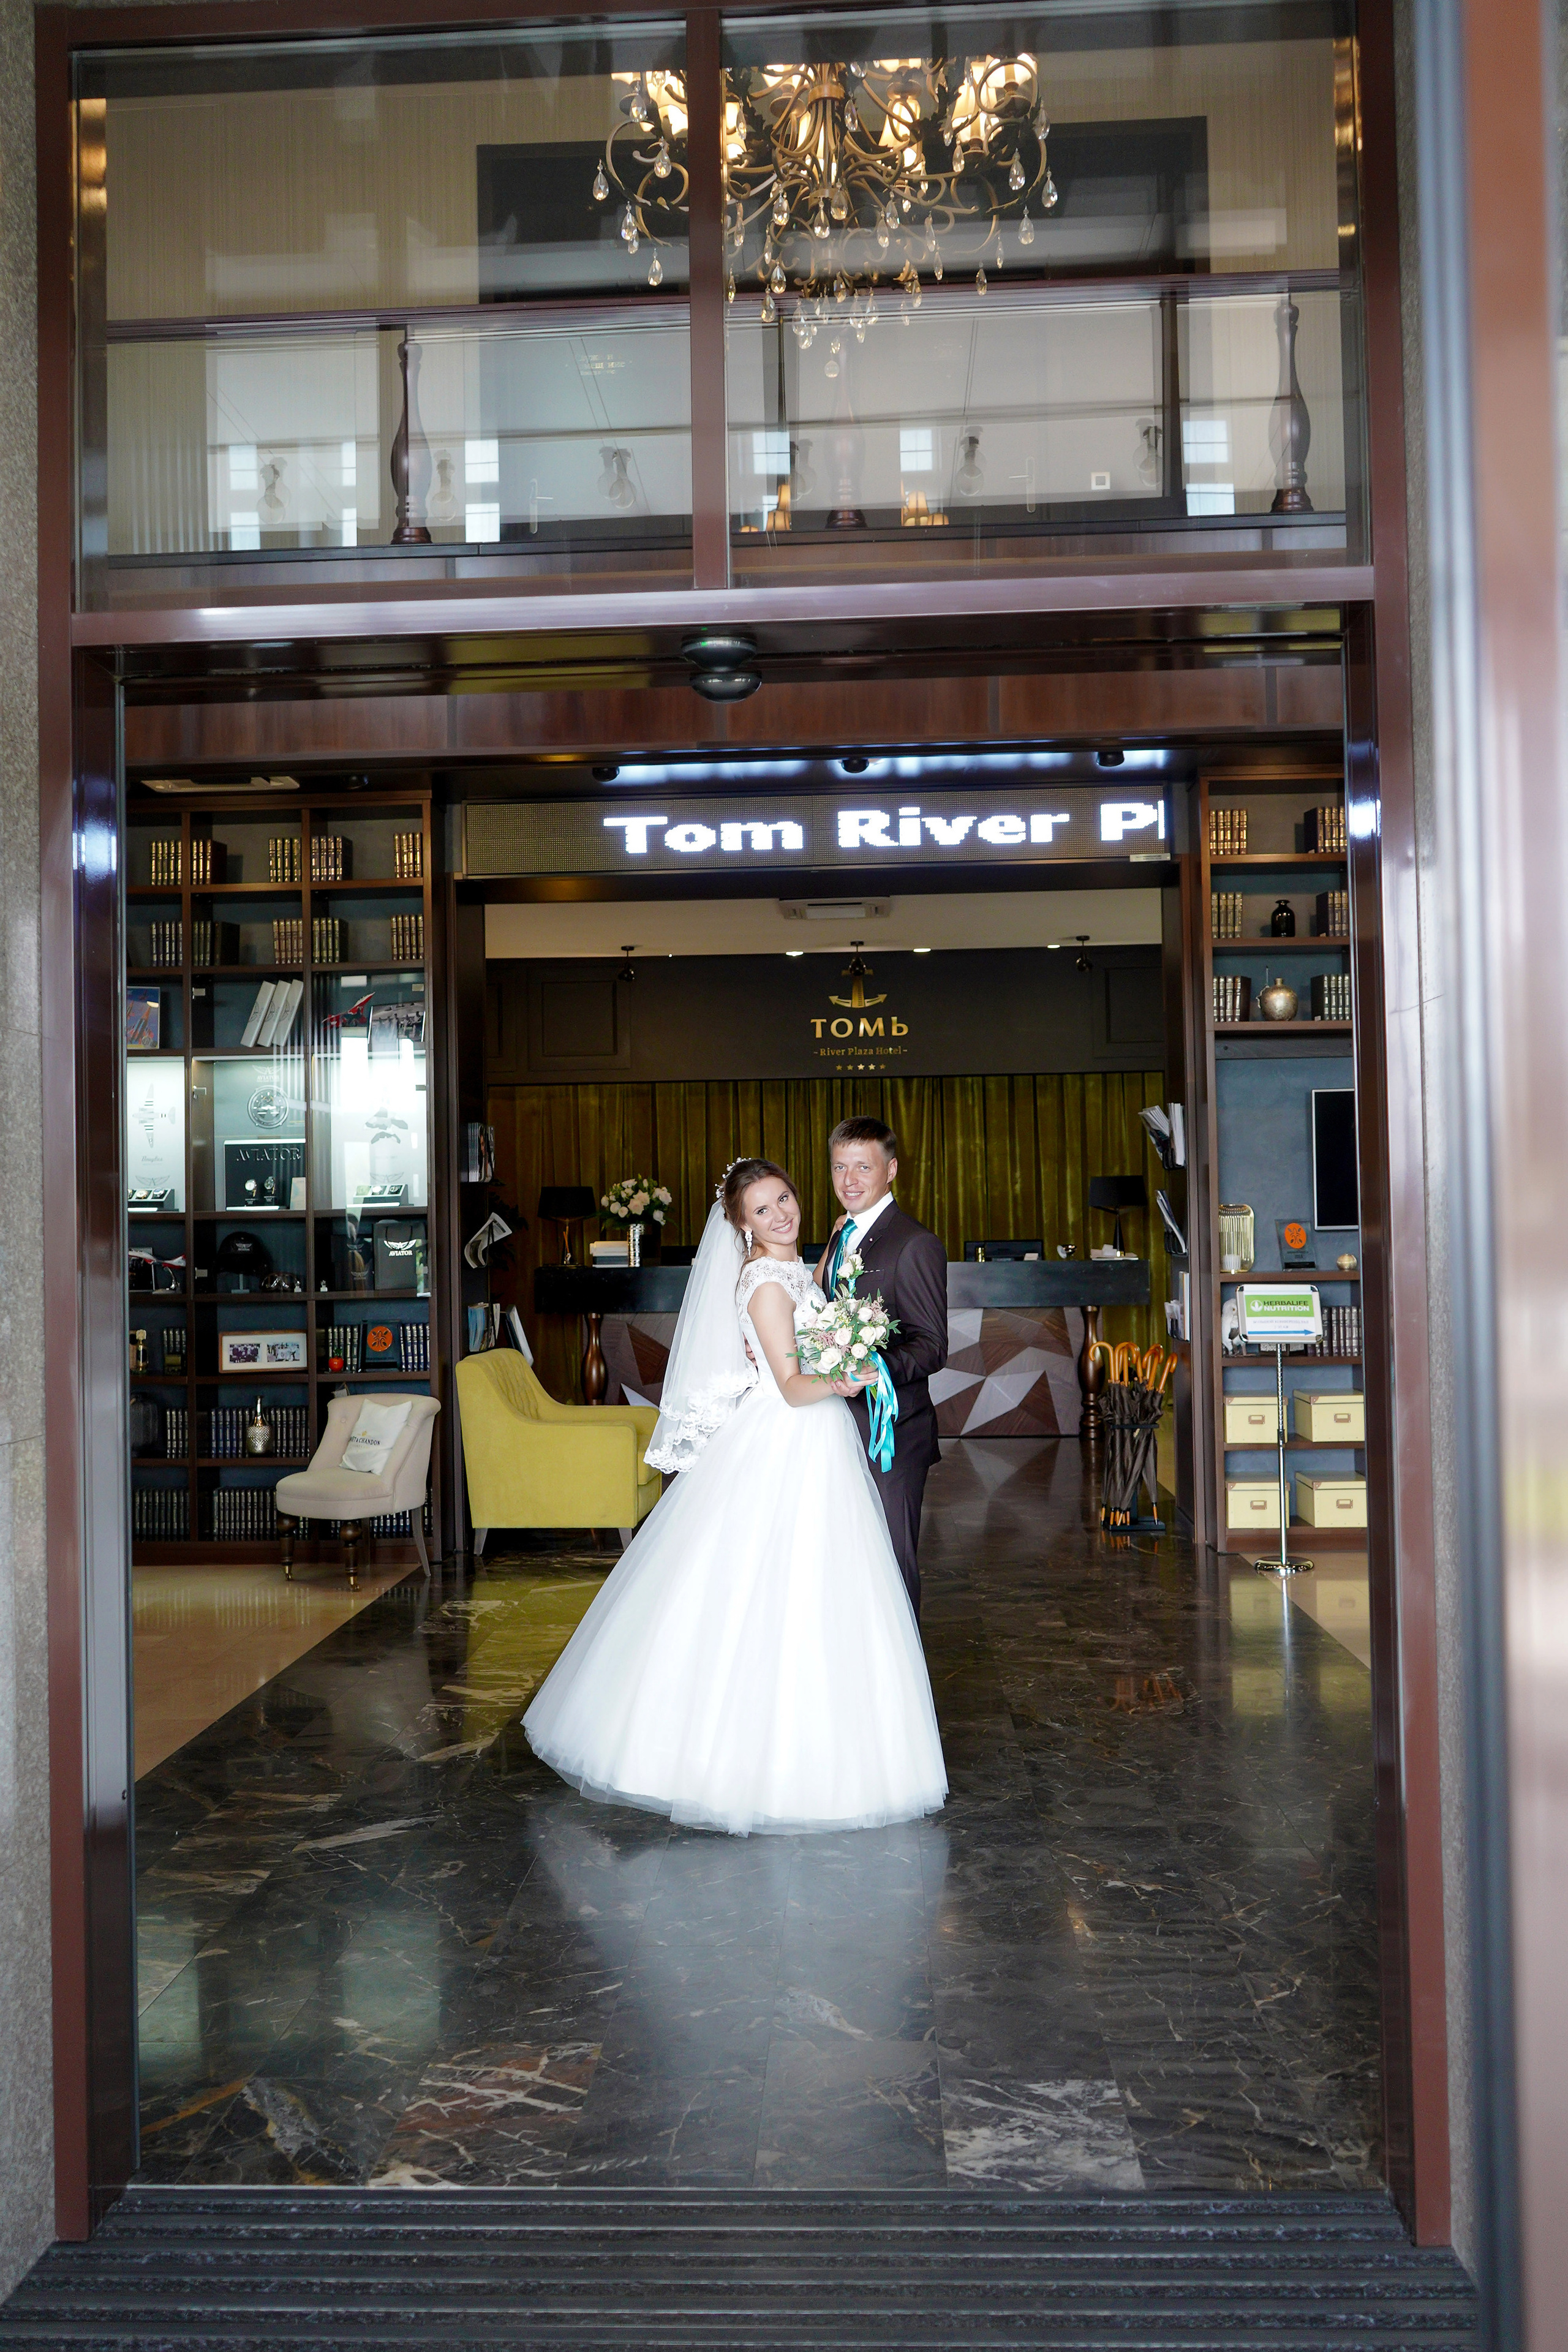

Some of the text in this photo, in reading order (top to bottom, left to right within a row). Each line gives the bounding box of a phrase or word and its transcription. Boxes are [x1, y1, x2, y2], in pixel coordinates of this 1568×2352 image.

[603, 816, 803, 853] Tom
[837, 807, 1069, 847] River
[810, 1016, 908, 1038] ТОМЬ
[820, 1046, 902, 1056] River Plaza Hotel
[236, 1148, 301, 1161] AVIATOR
